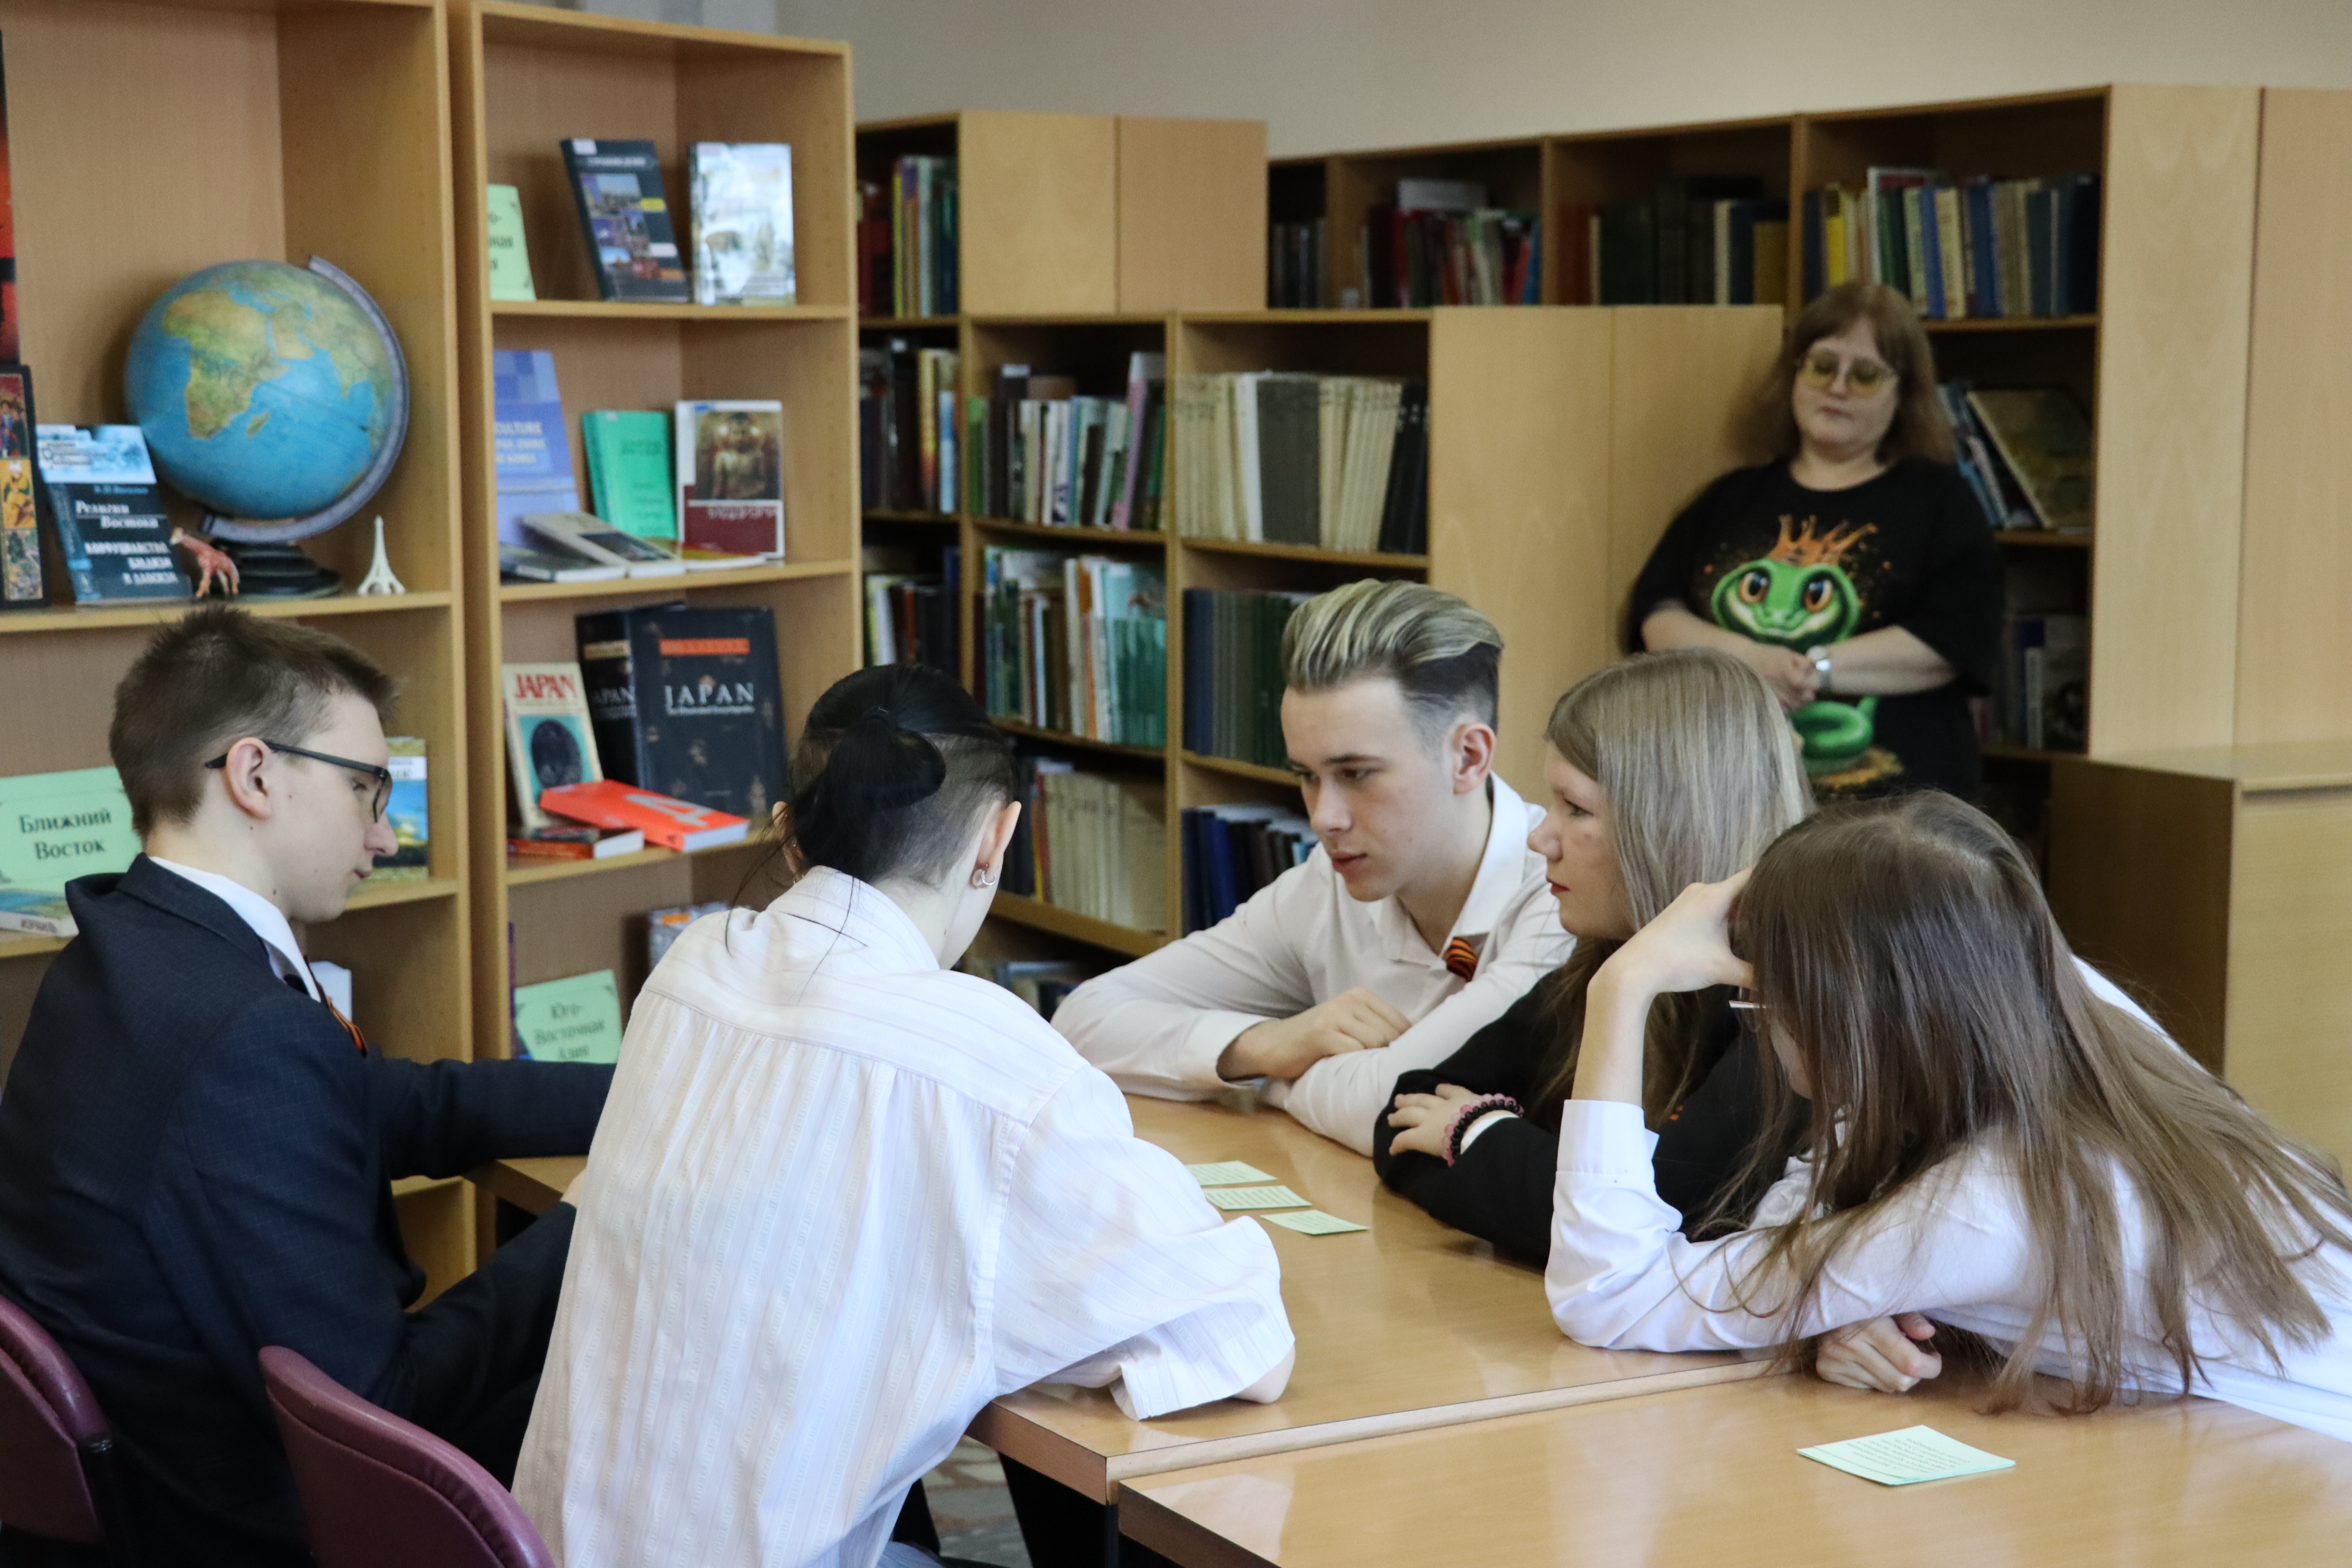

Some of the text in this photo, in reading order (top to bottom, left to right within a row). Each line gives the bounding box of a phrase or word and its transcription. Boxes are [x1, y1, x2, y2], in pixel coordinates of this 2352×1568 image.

[514, 672, 577, 699] JAPAN
[664, 682, 754, 711] JAPAN
[19, 809, 112, 833] Ближний
[34, 840, 105, 859] Восток
[535, 1021, 604, 1045] Восточная
